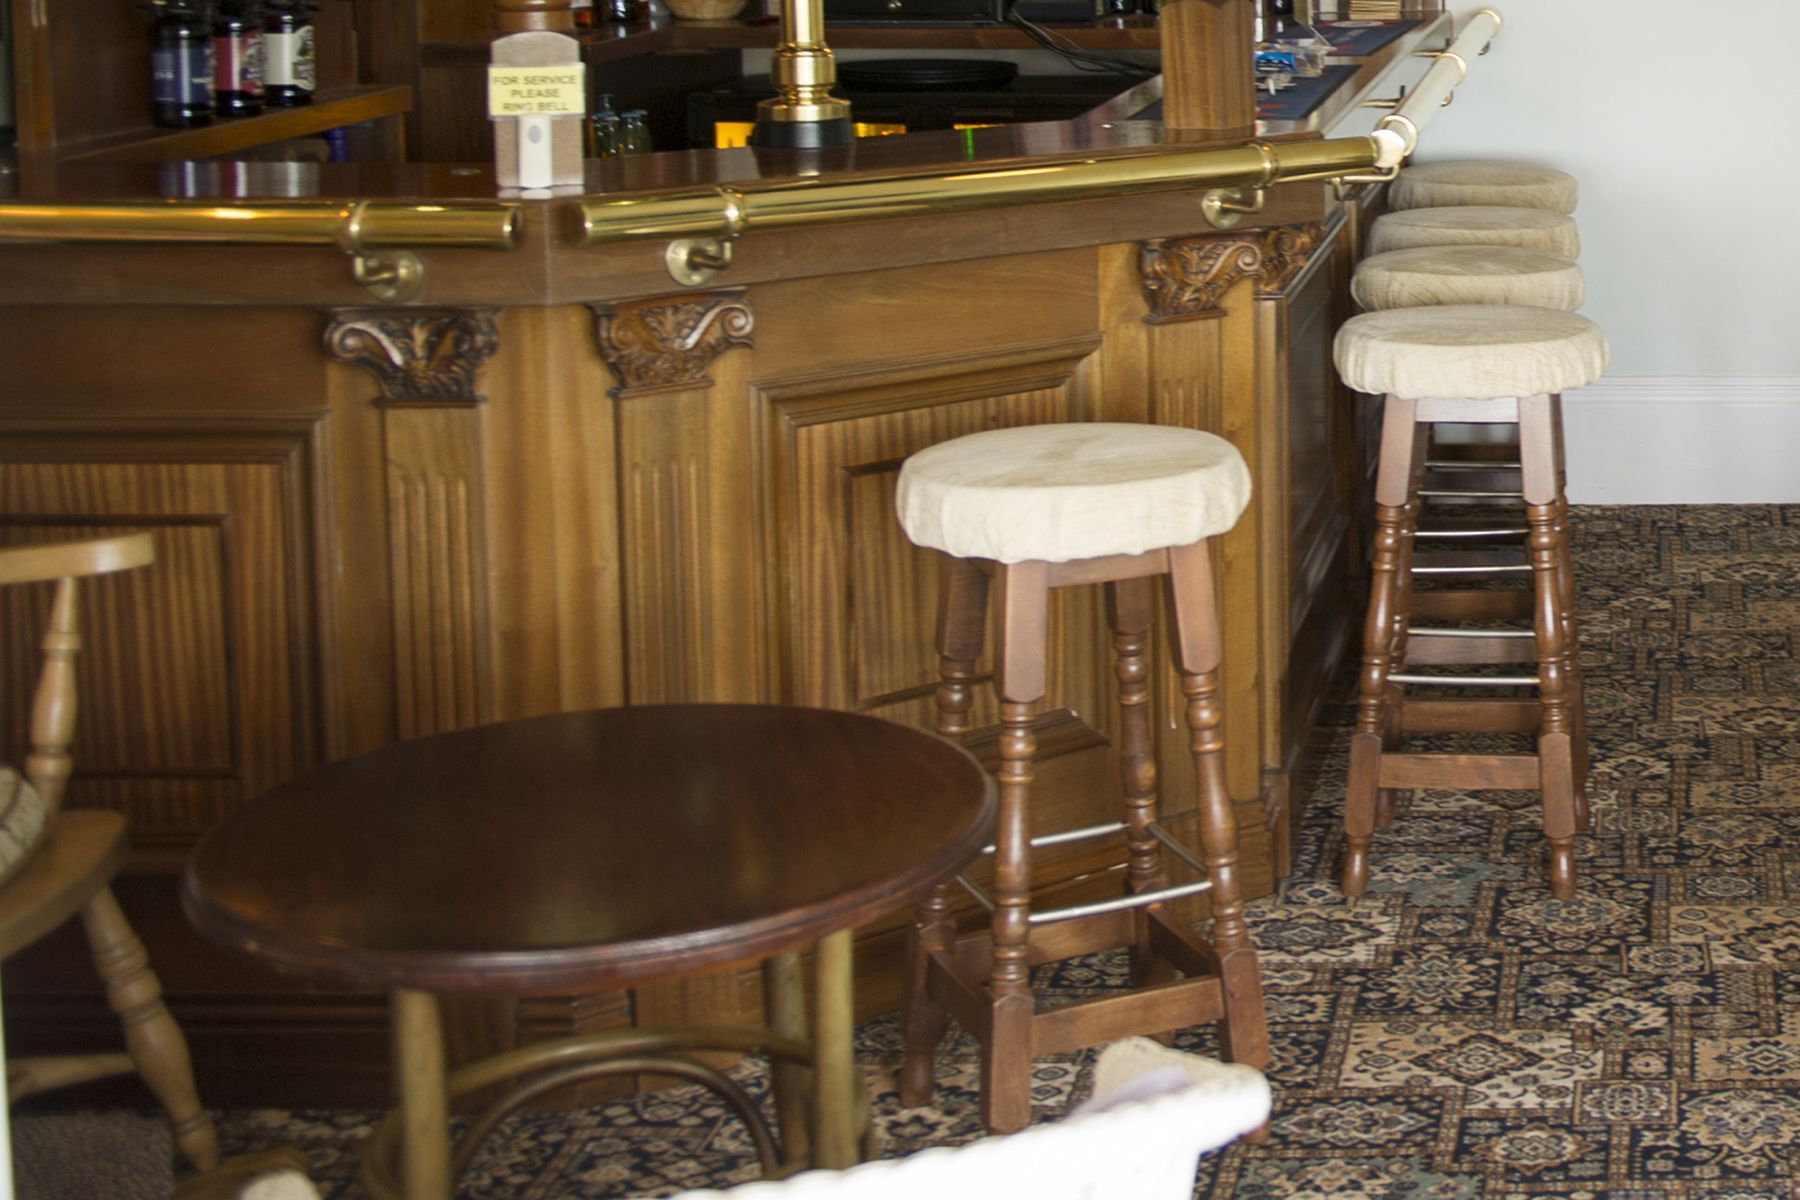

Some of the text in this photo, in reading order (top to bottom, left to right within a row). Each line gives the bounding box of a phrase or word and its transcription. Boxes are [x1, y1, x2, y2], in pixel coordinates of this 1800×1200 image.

[493, 75, 577, 86] FOR SERVICE
[511, 89, 560, 98] PLEASE
[503, 102, 570, 112] RING BELL
